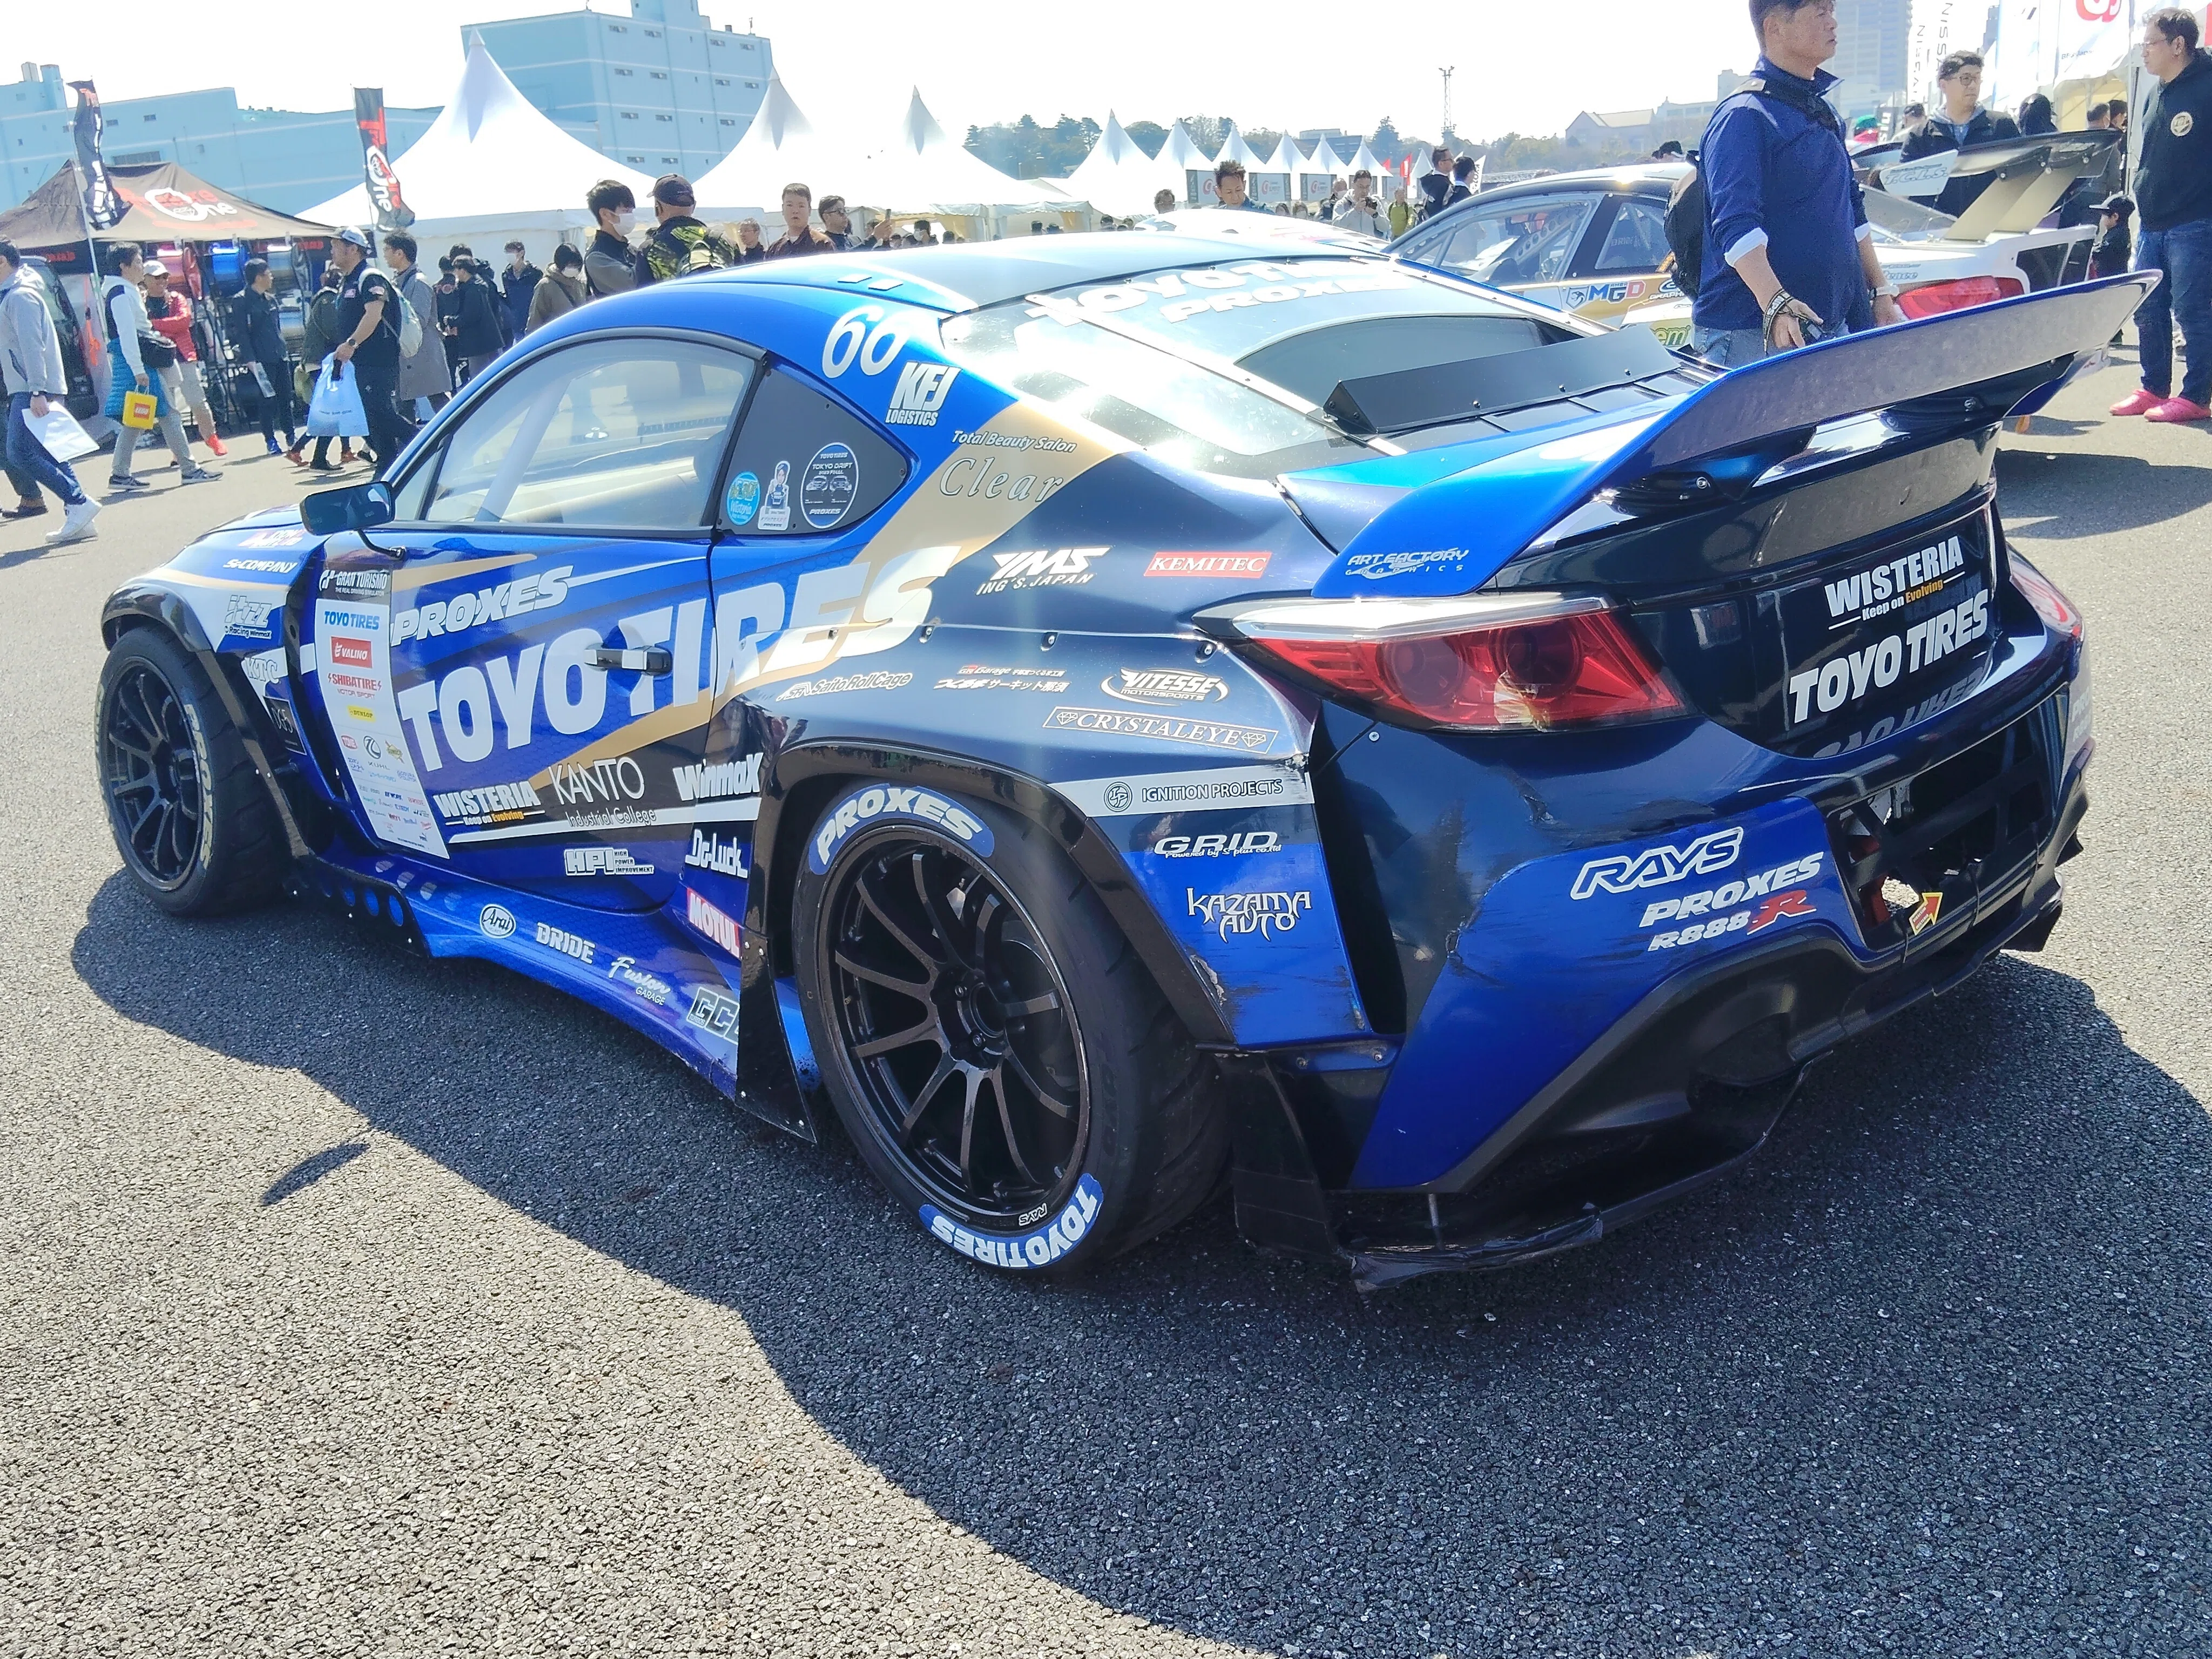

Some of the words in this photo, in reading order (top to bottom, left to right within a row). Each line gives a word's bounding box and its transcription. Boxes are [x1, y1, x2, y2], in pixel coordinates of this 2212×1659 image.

[885, 408, 939, 427] LOGISTICS
[952, 430, 988, 446] Total
[985, 433, 1035, 451] Beauty
[1034, 436, 1077, 453] Salon
[940, 457, 1063, 503] Clear
[1150, 556, 1268, 574] KEMITEC
[1345, 565, 1464, 575] GRAPHICS
[1824, 535, 1964, 617] WISTERIA
[336, 571, 355, 588] GRAN
[355, 571, 388, 590] TURISMO
[224, 595, 272, 628] itzz
[391, 565, 574, 648] PROXES
[1862, 601, 1890, 622] Keep
[1891, 596, 1905, 611] on
[1905, 578, 1944, 604] Evolving
[229, 626, 249, 638] Racing
[324, 611, 349, 627] TOYO
[350, 614, 380, 630] TIRES
[342, 648, 368, 660] VALINO
[398, 628, 608, 772] TOYO
[618, 545, 962, 717] TIRES
[1789, 635, 1903, 724] TOYO
[1906, 589, 1989, 674] TIRES
[244, 657, 279, 684] KTC
[332, 673, 377, 691] SHIBATIRE
[976, 666, 1011, 676] Garage
[1121, 671, 1223, 693] VITESSE
[337, 688, 356, 698] MOTOR
[356, 690, 375, 700] SPORT
[1121, 689, 1205, 701] MOTORSPORTS
[353, 710, 373, 719] DUNLOP
[1075, 712, 1243, 747] CRYSTALEYE
[368, 761, 390, 771] KUHL
[548, 757, 645, 806] KANTO
[1142, 785, 1210, 803] IGNITION
[1210, 779, 1284, 798] PROJECTS
[433, 780, 541, 818] WISTERIA
[463, 815, 481, 826] Keep
[482, 815, 491, 824] on
[491, 811, 524, 823] Evolving
[565, 811, 610, 828] Industrial
[610, 806, 657, 826] College
[817, 788, 983, 865] PROXES
[1154, 832, 1278, 855] GRID
[1165, 849, 1204, 859] Powered
[1206, 849, 1219, 858] by
[1232, 847, 1253, 857] plus
[565, 848, 615, 874] HPI
[1570, 826, 1744, 900] RAYS
[1639, 852, 1824, 928] PROXES
[482, 908, 511, 931] Arai
[689, 892, 740, 959] MOTUL
[1219, 906, 1296, 943] AUTO
[536, 922, 596, 965] BRIDE
[609, 956, 671, 995] Fusion
[635, 987, 666, 1006] GARAGE
[687, 987, 740, 1043] GC
[1018, 1202, 1048, 1226] RAYS
[1026, 1185, 1097, 1265] TOYO
[931, 1216, 1029, 1267] TIRES
